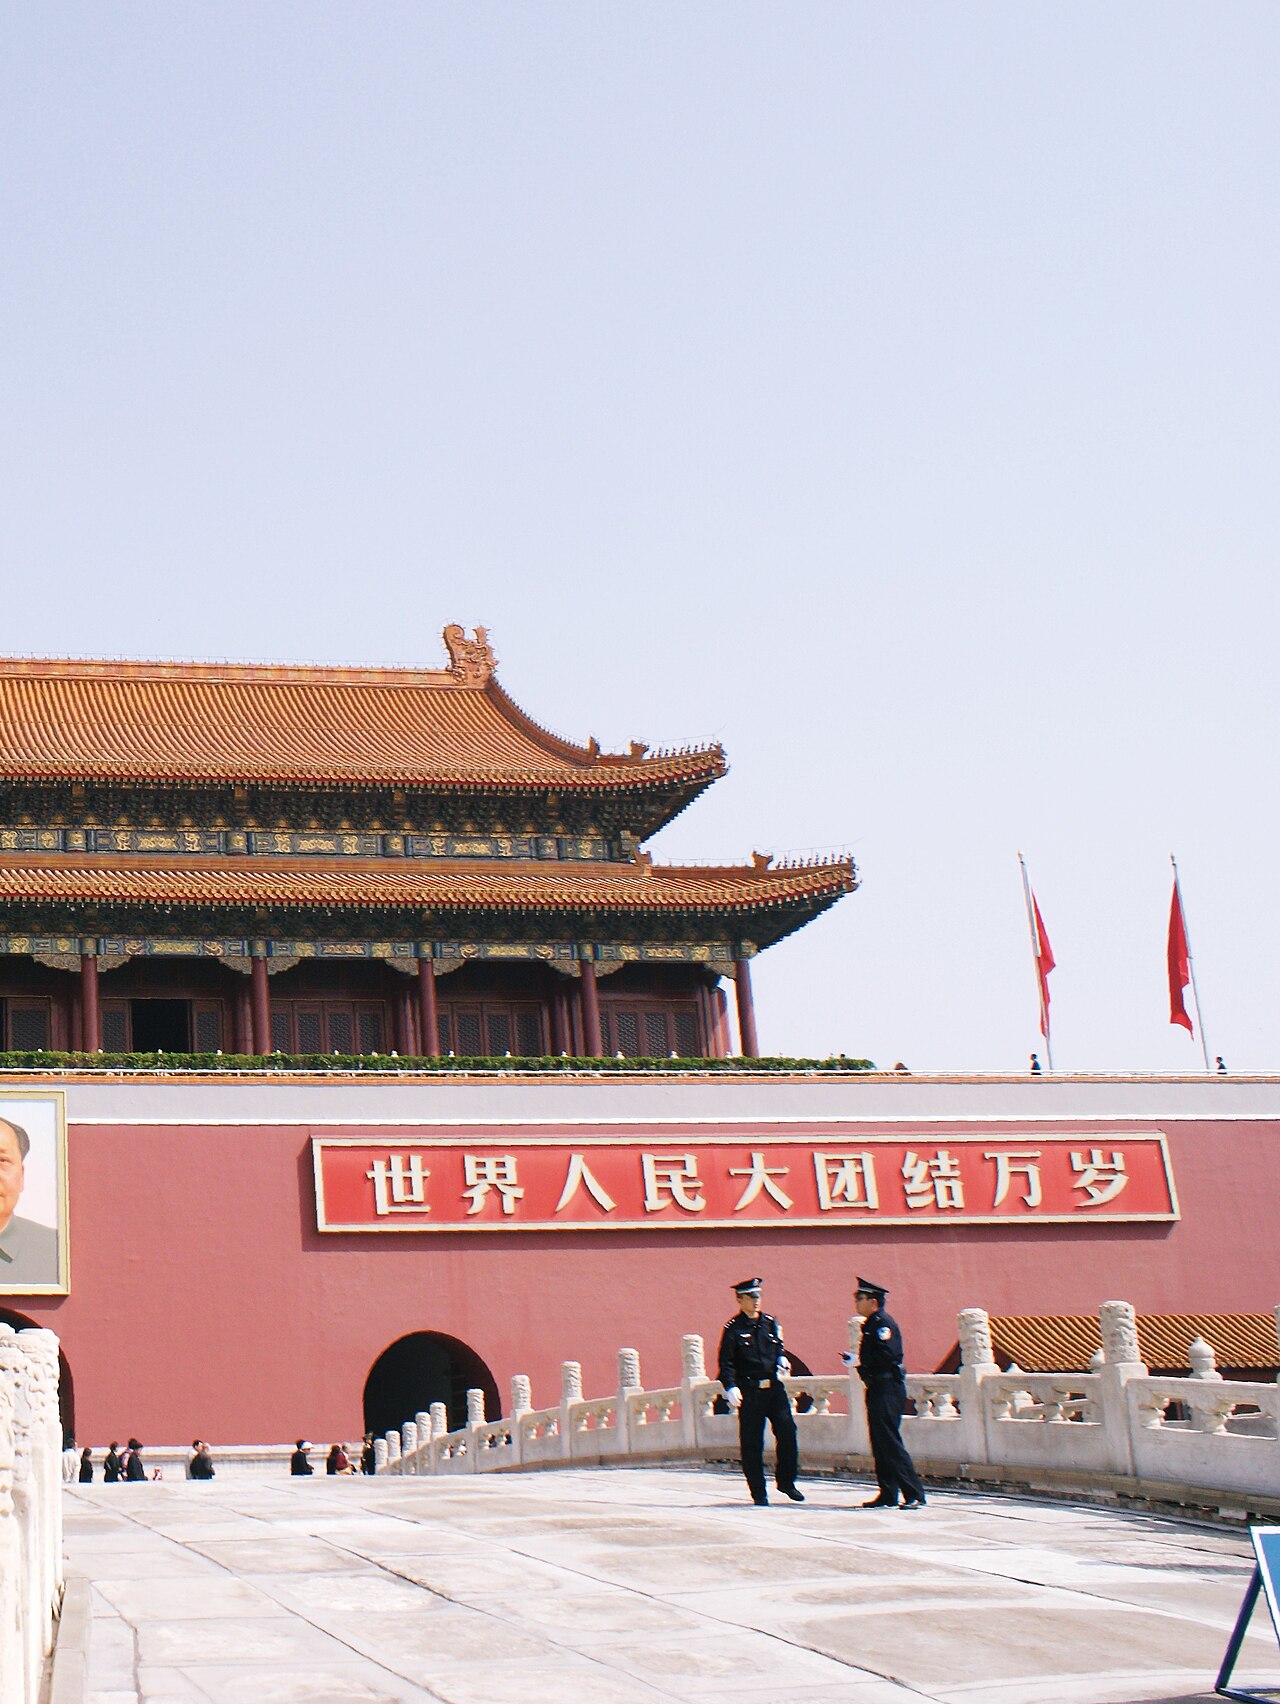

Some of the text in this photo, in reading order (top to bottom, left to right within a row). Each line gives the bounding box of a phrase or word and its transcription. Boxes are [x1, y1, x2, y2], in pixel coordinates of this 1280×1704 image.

[366, 1149, 1130, 1215] 世界人民大团结万岁
